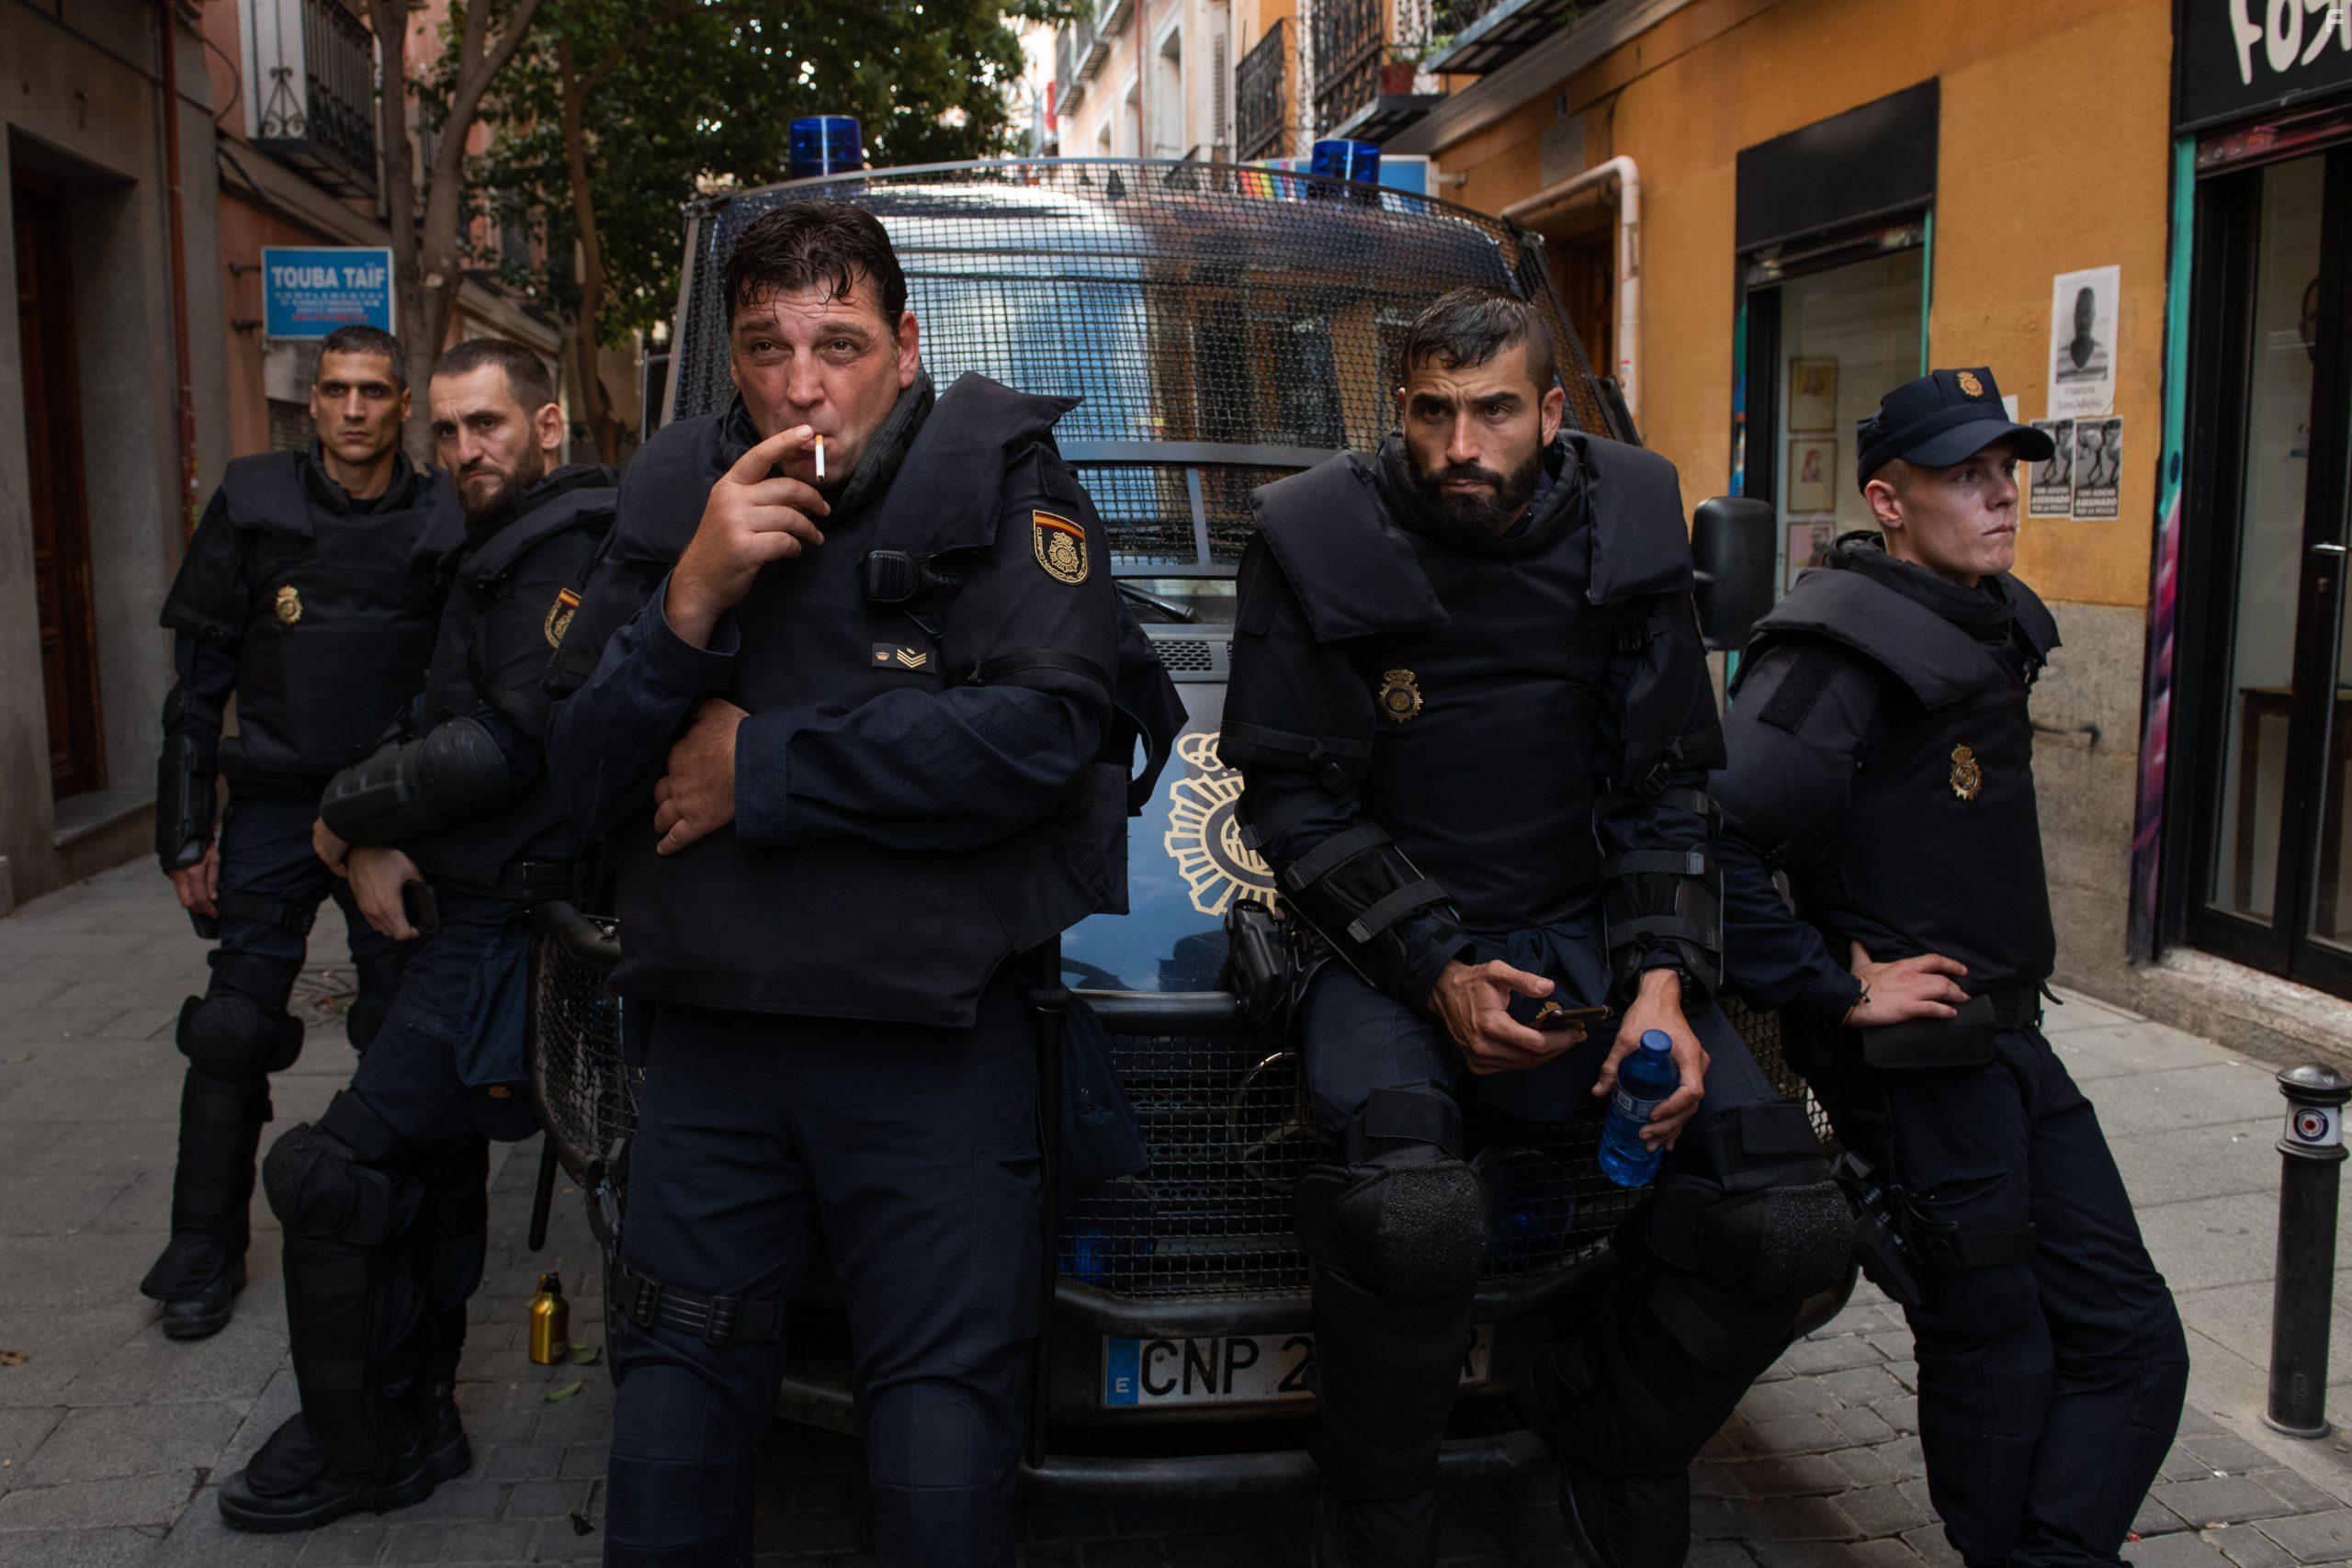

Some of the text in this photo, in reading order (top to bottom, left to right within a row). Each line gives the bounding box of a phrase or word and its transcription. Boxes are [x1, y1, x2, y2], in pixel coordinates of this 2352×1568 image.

[271, 266, 339, 288] TOUBA
[1141, 1337, 1260, 1396] CNP
[1115, 1377, 1130, 1394] E
